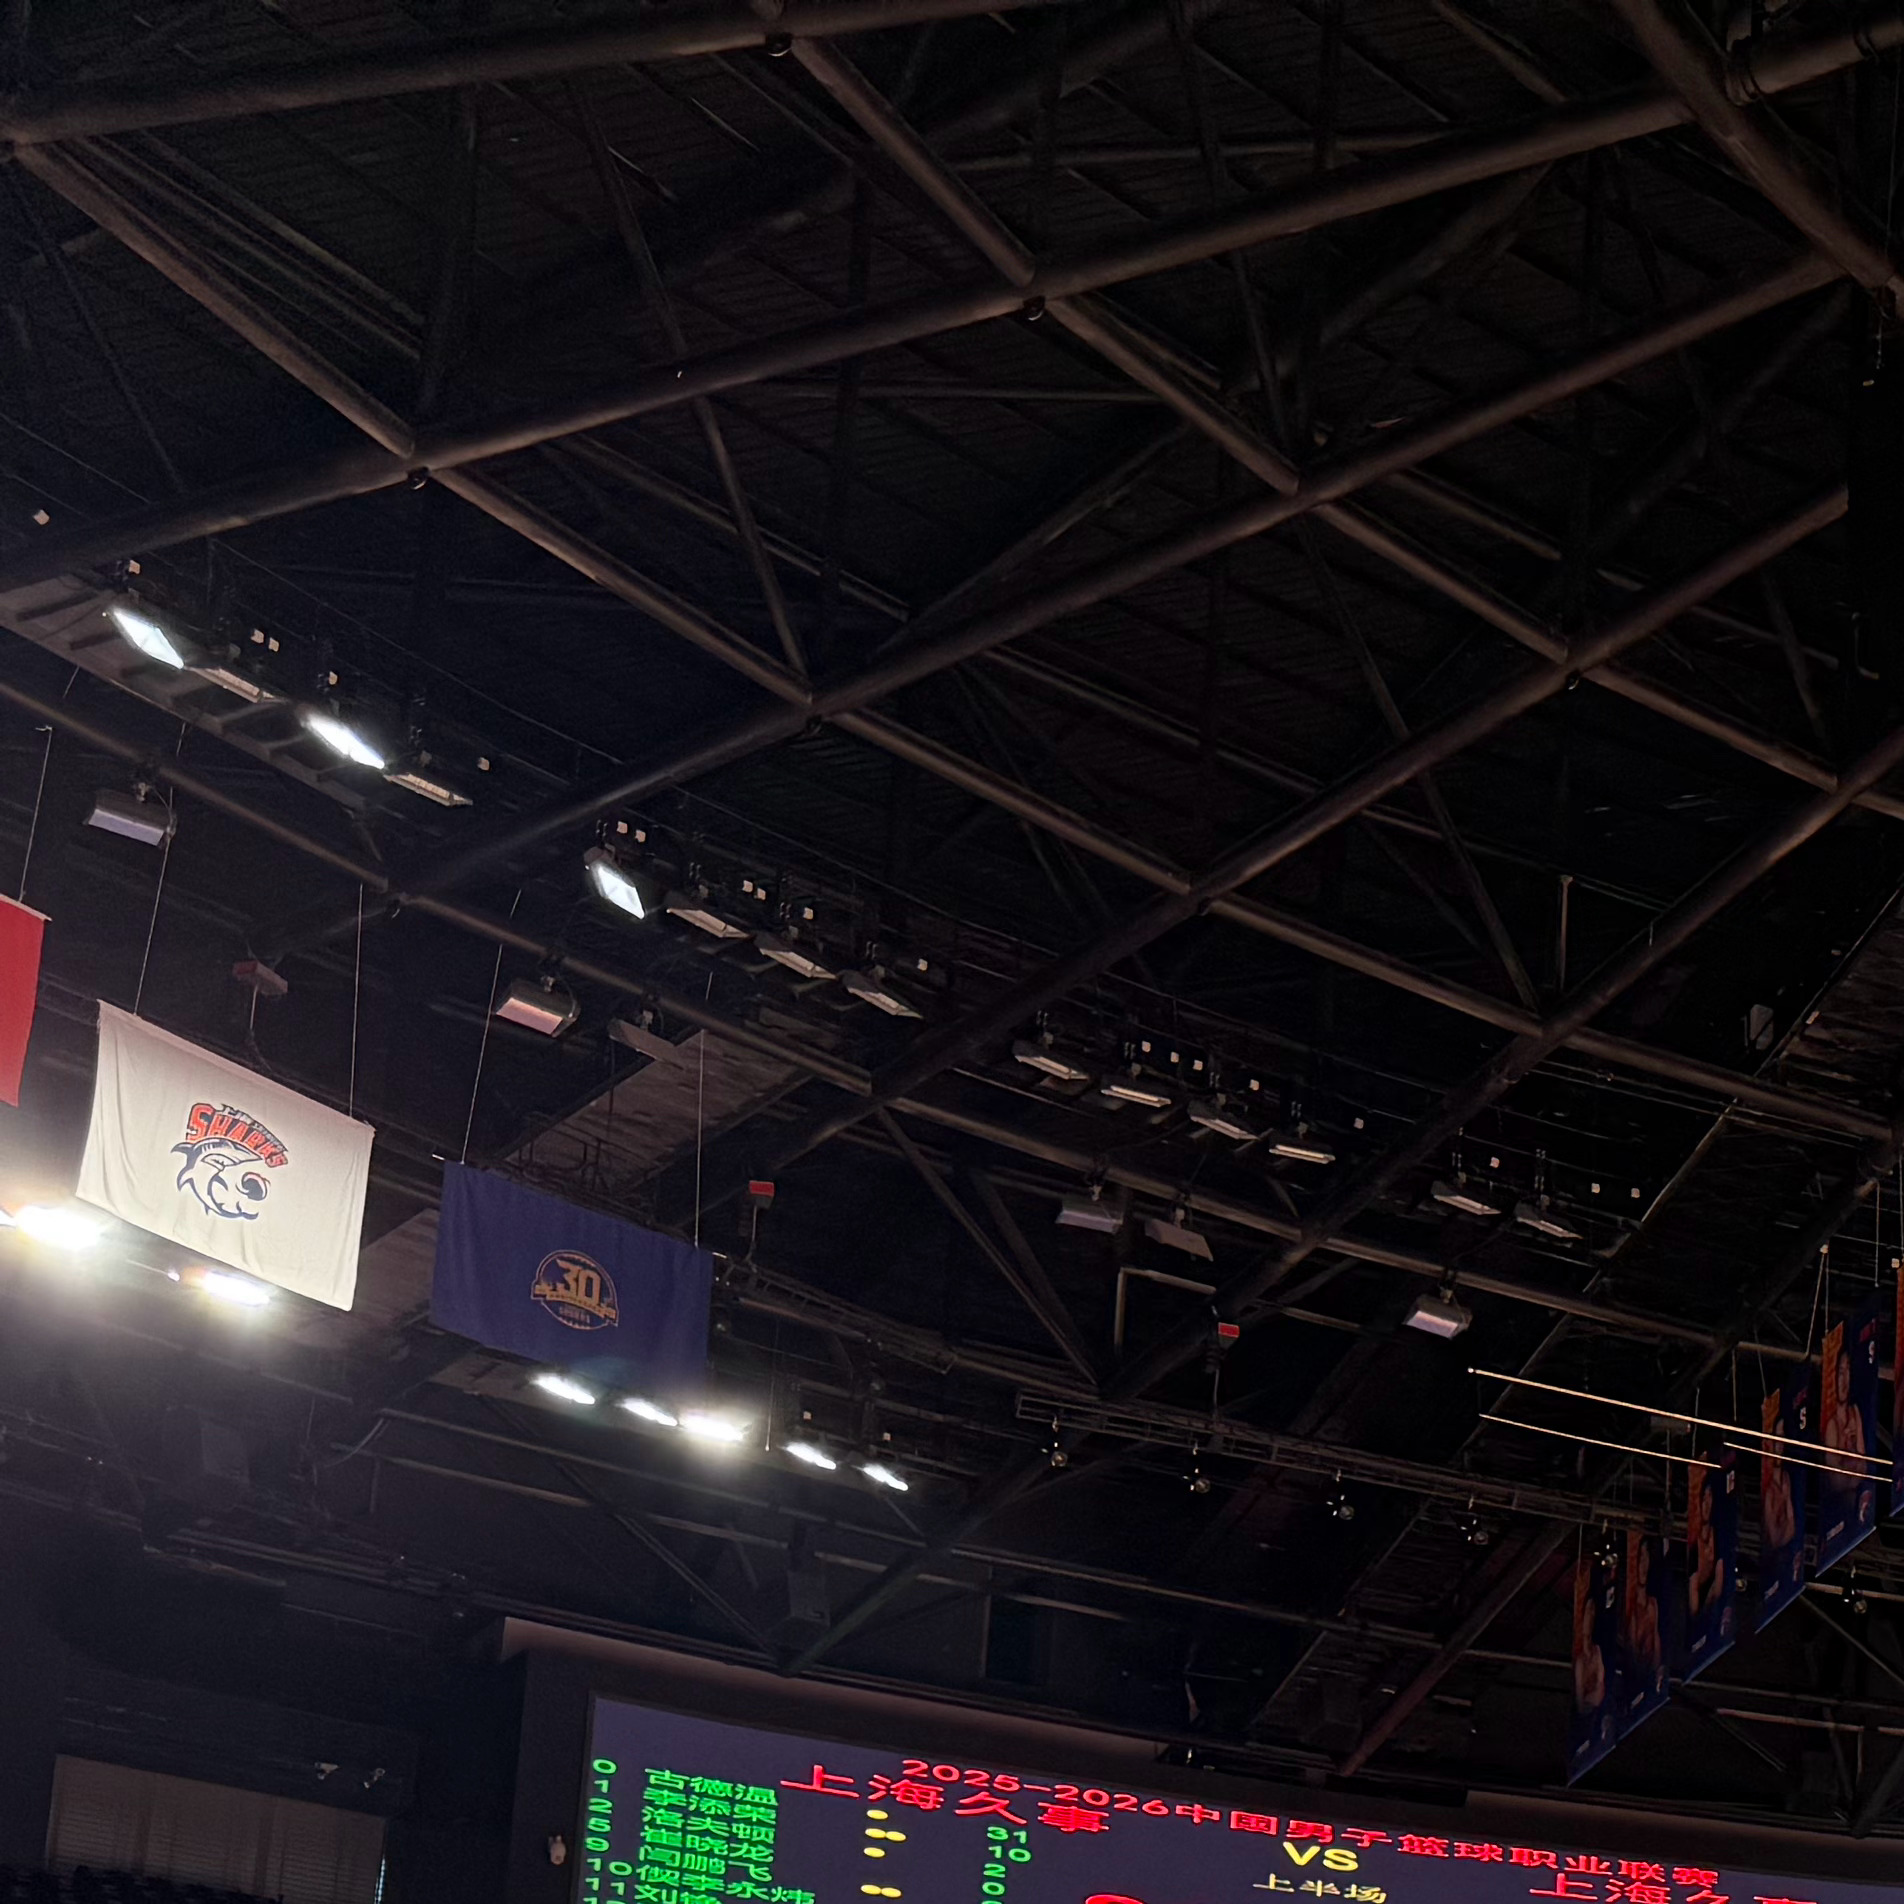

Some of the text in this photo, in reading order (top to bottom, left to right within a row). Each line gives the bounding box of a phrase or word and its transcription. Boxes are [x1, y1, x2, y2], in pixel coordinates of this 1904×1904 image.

[555, 1258, 602, 1307] 30
[593, 1759, 1026, 1844] 0 古德温 31
[596, 1780, 608, 1792] 1
[990, 1846, 1031, 1862] 10
[780, 1764, 1110, 1832] 上海久事
[586, 1837, 609, 1851] 9
[588, 1817, 1005, 1895] 5 崔晓龙 0
[589, 1798, 1005, 1878] 2 洛夫顿 2
[1283, 1841, 1359, 1872] VS
[586, 1878, 624, 1895] 11
[587, 1858, 632, 1875] 10
[1252, 1874, 1387, 1904] 上半场
